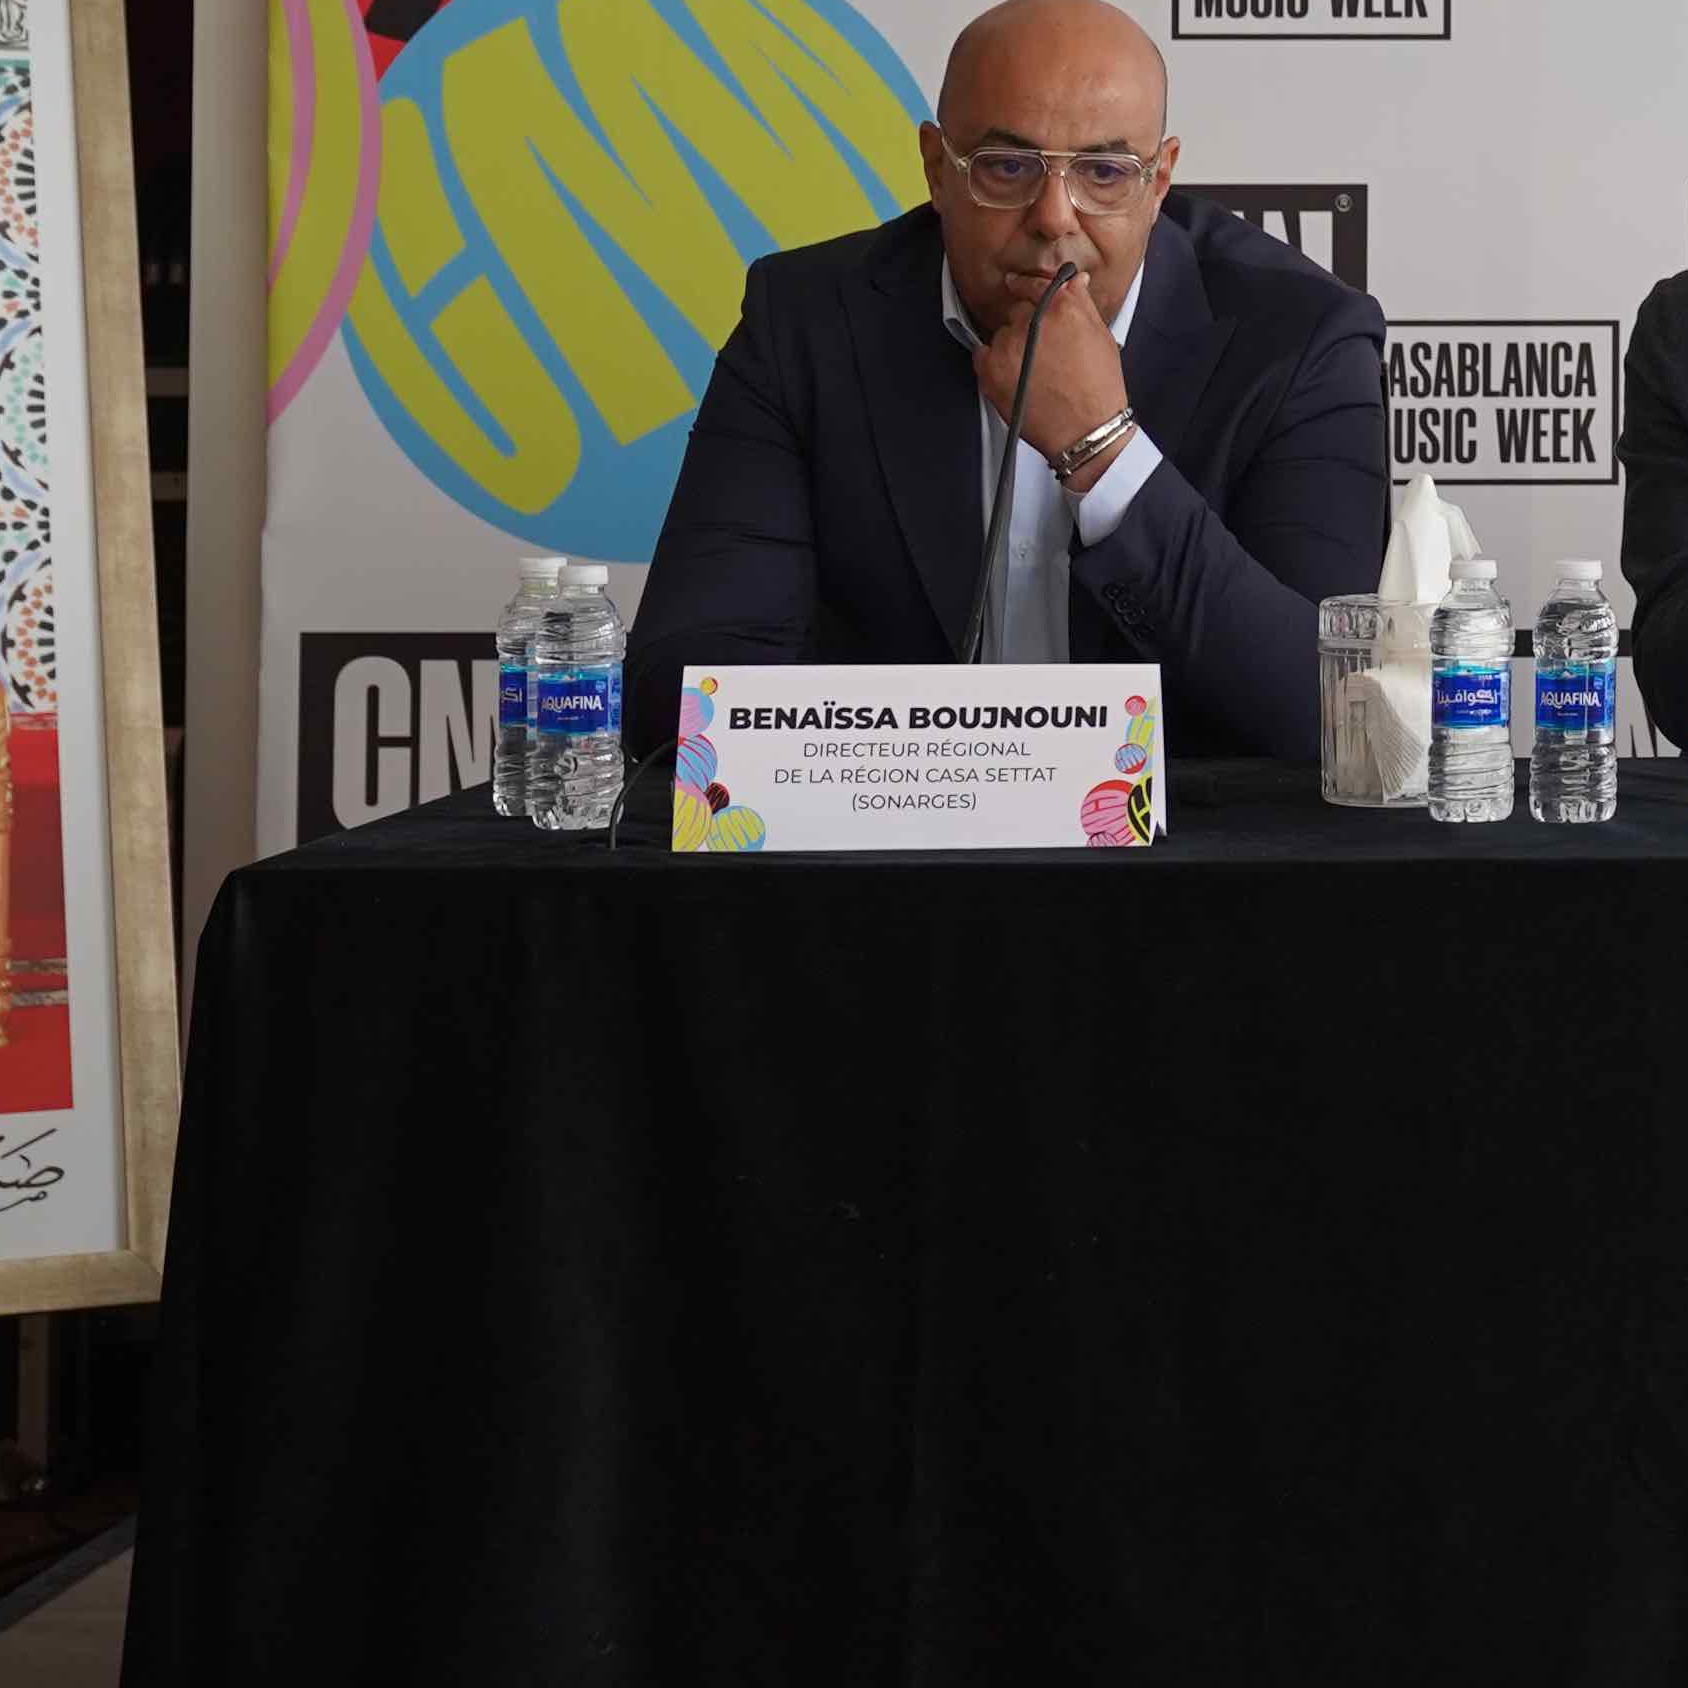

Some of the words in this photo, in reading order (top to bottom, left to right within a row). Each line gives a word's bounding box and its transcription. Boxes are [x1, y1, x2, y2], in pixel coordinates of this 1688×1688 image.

[1388, 342, 1597, 398] ASABLANCA
[1393, 408, 1477, 464] USIC
[1496, 408, 1597, 464] WEEK
[541, 695, 604, 713] AQUAFINA
[1540, 691, 1602, 709] AQUAFINA
[729, 700, 898, 730] BENAÏSSA
[909, 706, 1107, 729] BOUJNOUNI
[804, 742, 920, 758] DIRECTEUR
[927, 739, 1031, 757] RÉGIONAL
[775, 769, 803, 784] DE
[809, 769, 835, 784] LA
[841, 766, 919, 784] RÉGION
[926, 768, 980, 783] CASA
[985, 768, 1057, 782] SETTAT
[852, 792, 977, 812] (SONARGES)
